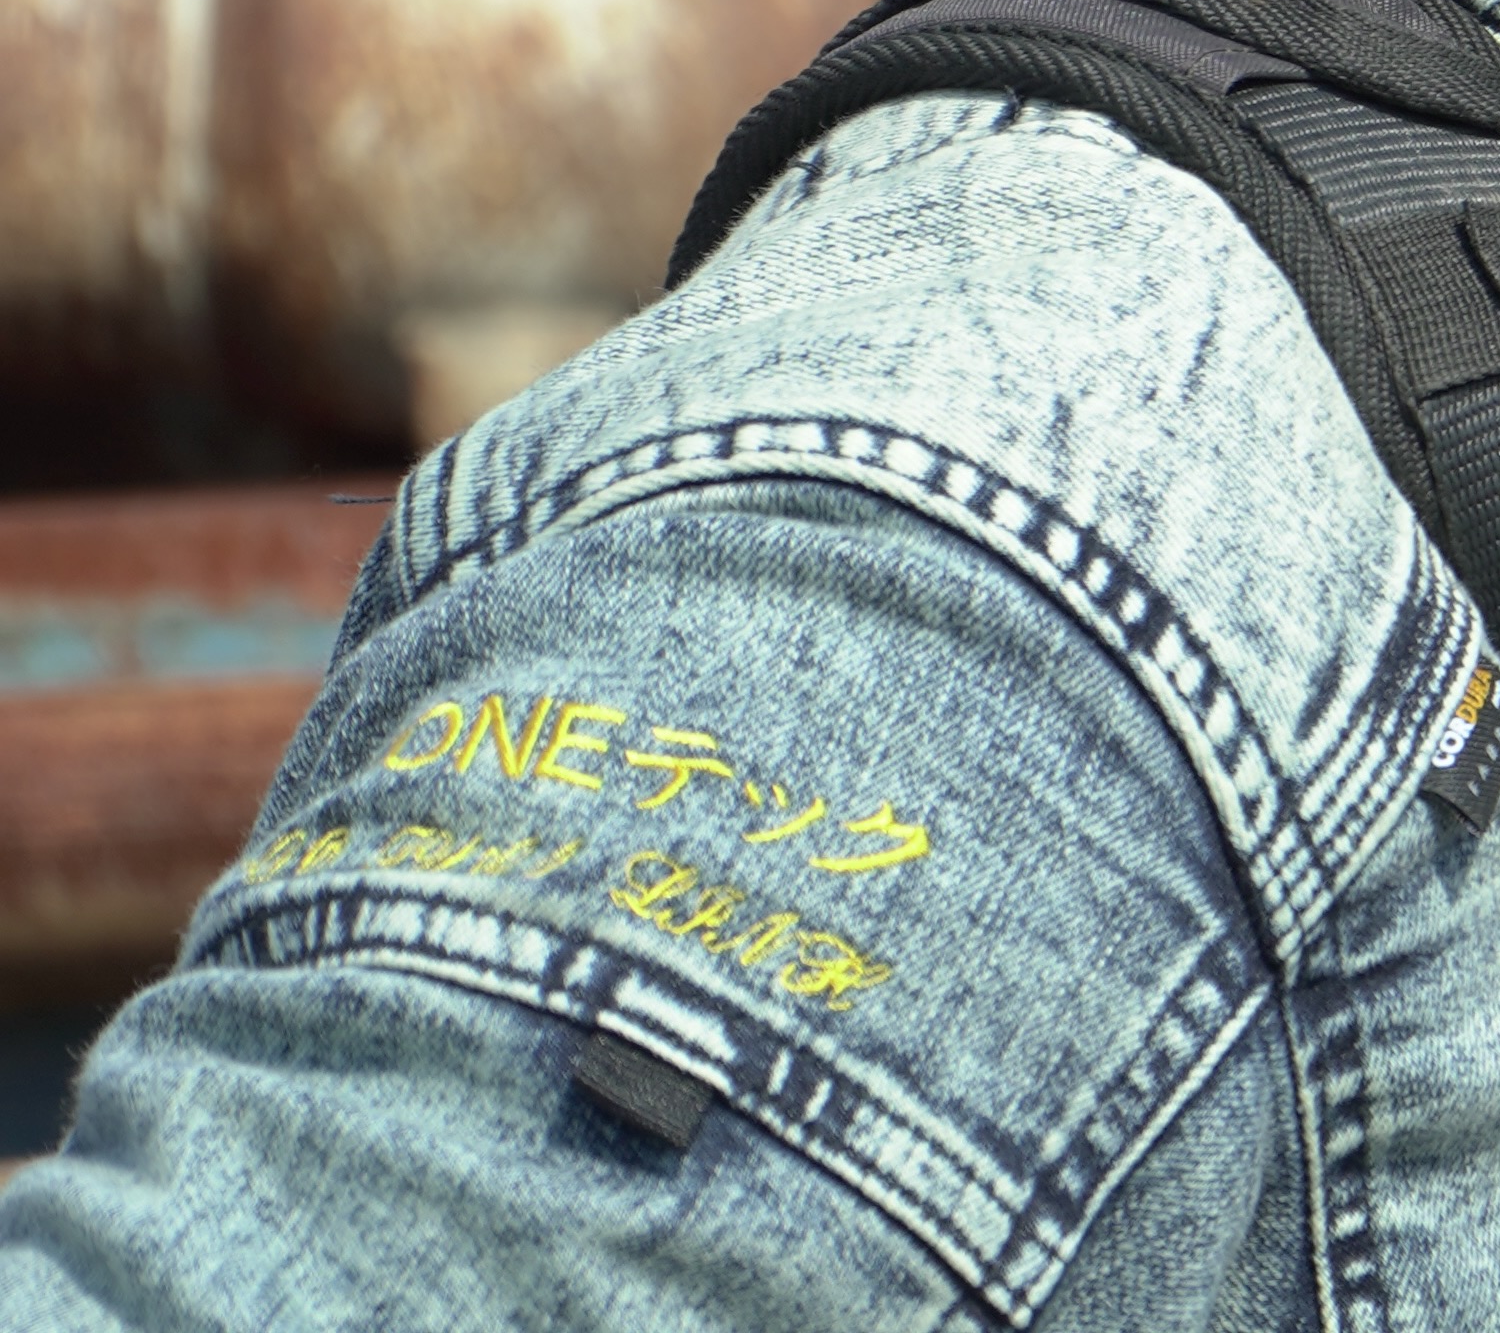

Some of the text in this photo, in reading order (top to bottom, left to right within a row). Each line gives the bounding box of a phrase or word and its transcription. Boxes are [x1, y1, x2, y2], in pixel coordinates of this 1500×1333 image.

[385, 695, 931, 874] ONEテック
[1432, 666, 1493, 769] CORDURA
